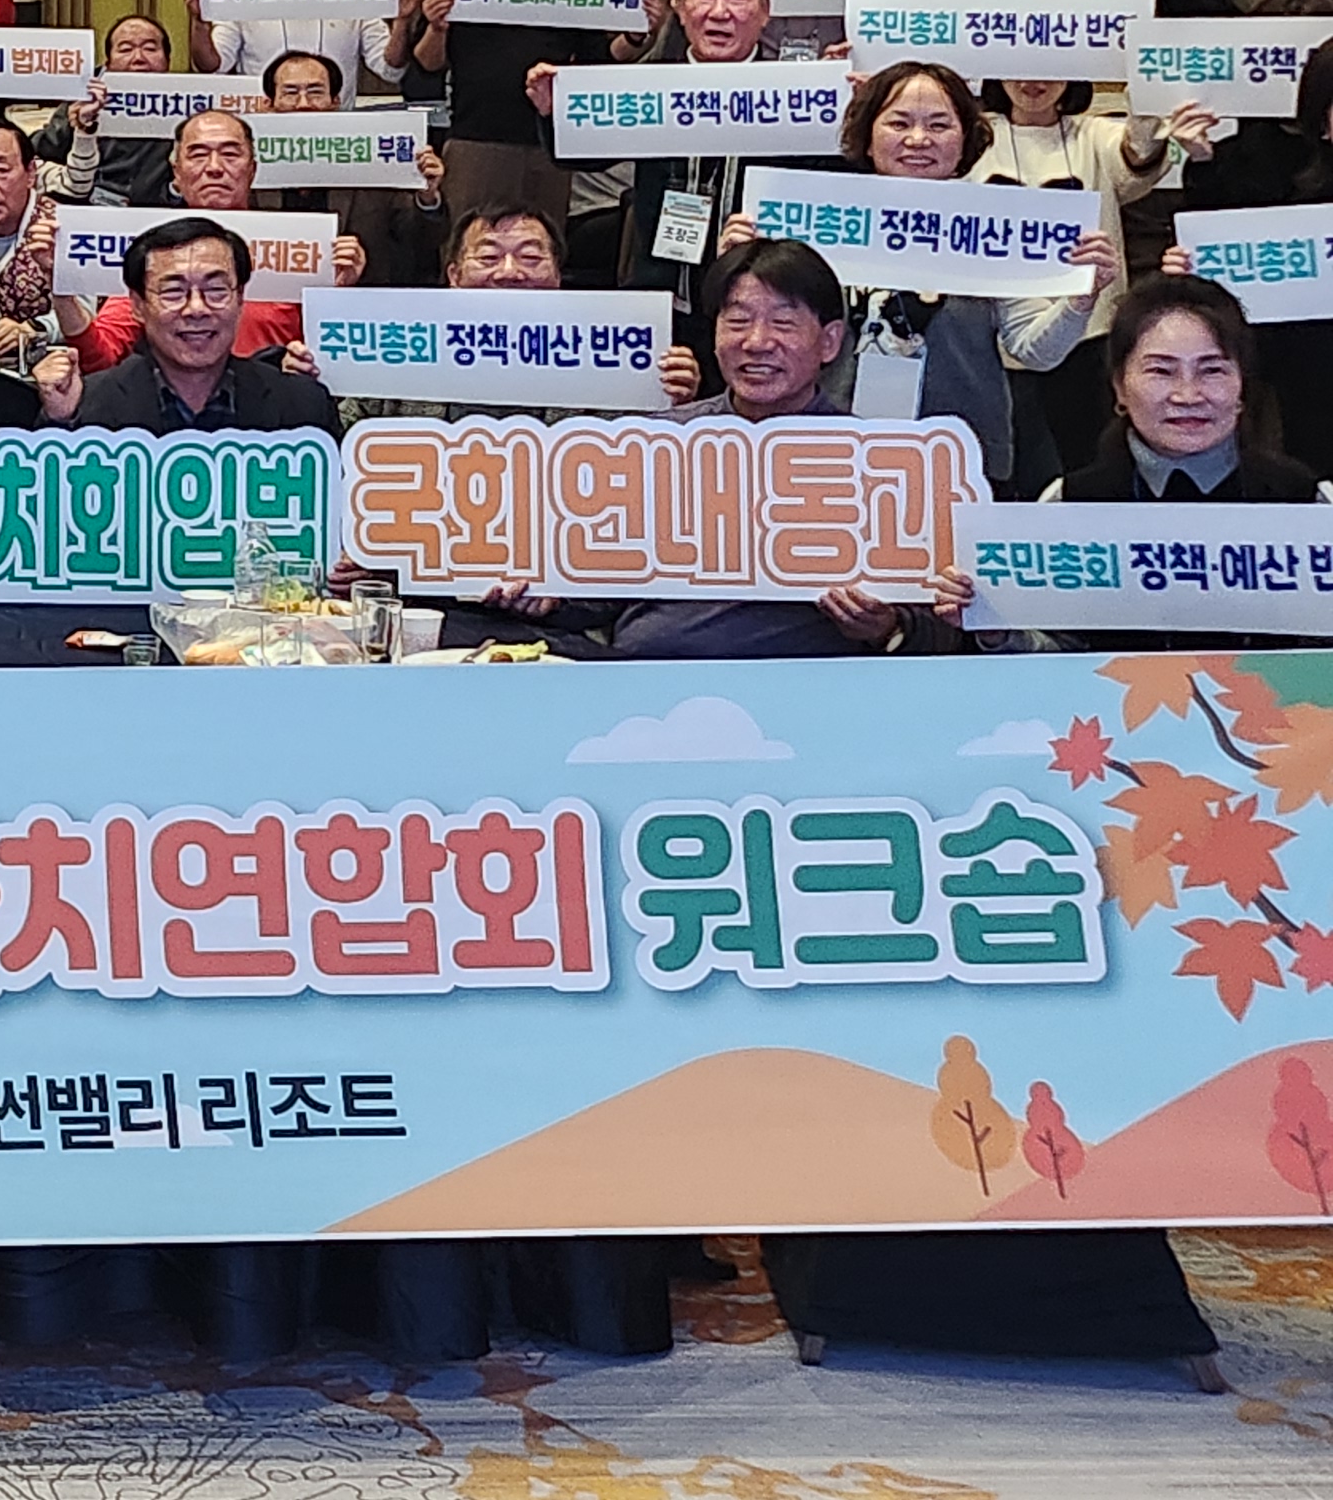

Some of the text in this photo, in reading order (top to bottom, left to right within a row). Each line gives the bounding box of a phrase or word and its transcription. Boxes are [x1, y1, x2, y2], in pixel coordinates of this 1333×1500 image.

[858, 11, 957, 45] 주민총회
[964, 12, 1077, 47] 정책·예산
[11, 48, 84, 75] 법제화
[1137, 46, 1307, 83] 주민총회 정책·
[566, 88, 839, 125] 주민총회 정책·예산 반영
[258, 134, 415, 165] 민자치박람회 부활
[755, 199, 871, 247] 주민총회
[879, 207, 1013, 258] 정책·예산
[1020, 220, 1084, 263] 반영
[318, 321, 653, 371] 주민총회 정책·예산 반영
[975, 540, 1121, 591] 주민총회
[1130, 542, 1299, 592] 정책·예산
[632, 800, 1089, 975] 워크숍
[200, 1070, 409, 1150] 리조트
